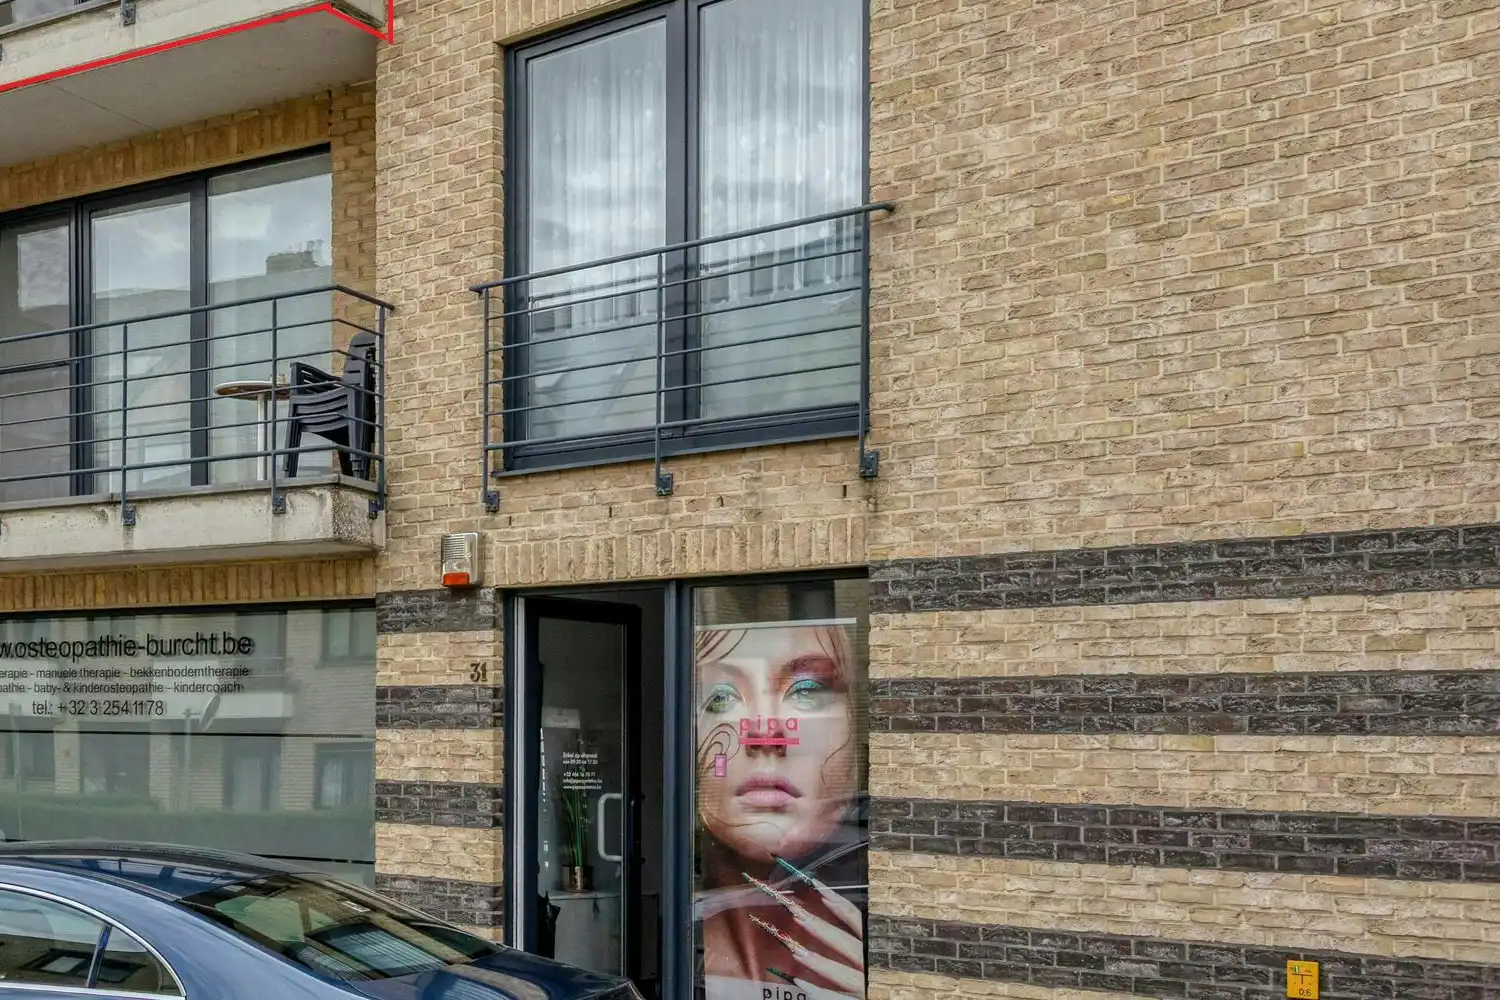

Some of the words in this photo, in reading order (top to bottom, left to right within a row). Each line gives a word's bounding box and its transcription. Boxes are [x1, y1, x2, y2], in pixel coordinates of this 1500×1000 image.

[36, 668, 77, 679] manuele
[79, 667, 121, 680] therapie
[130, 665, 249, 680] bekkenbodemtherapie
[470, 662, 487, 682] 31
[63, 683, 70, 692] &
[73, 681, 164, 695] kinderosteopathie
[173, 681, 242, 693] kindercoach
[90, 700, 98, 715] 3
[740, 714, 799, 737] pipa
[762, 986, 807, 1000] pipa
